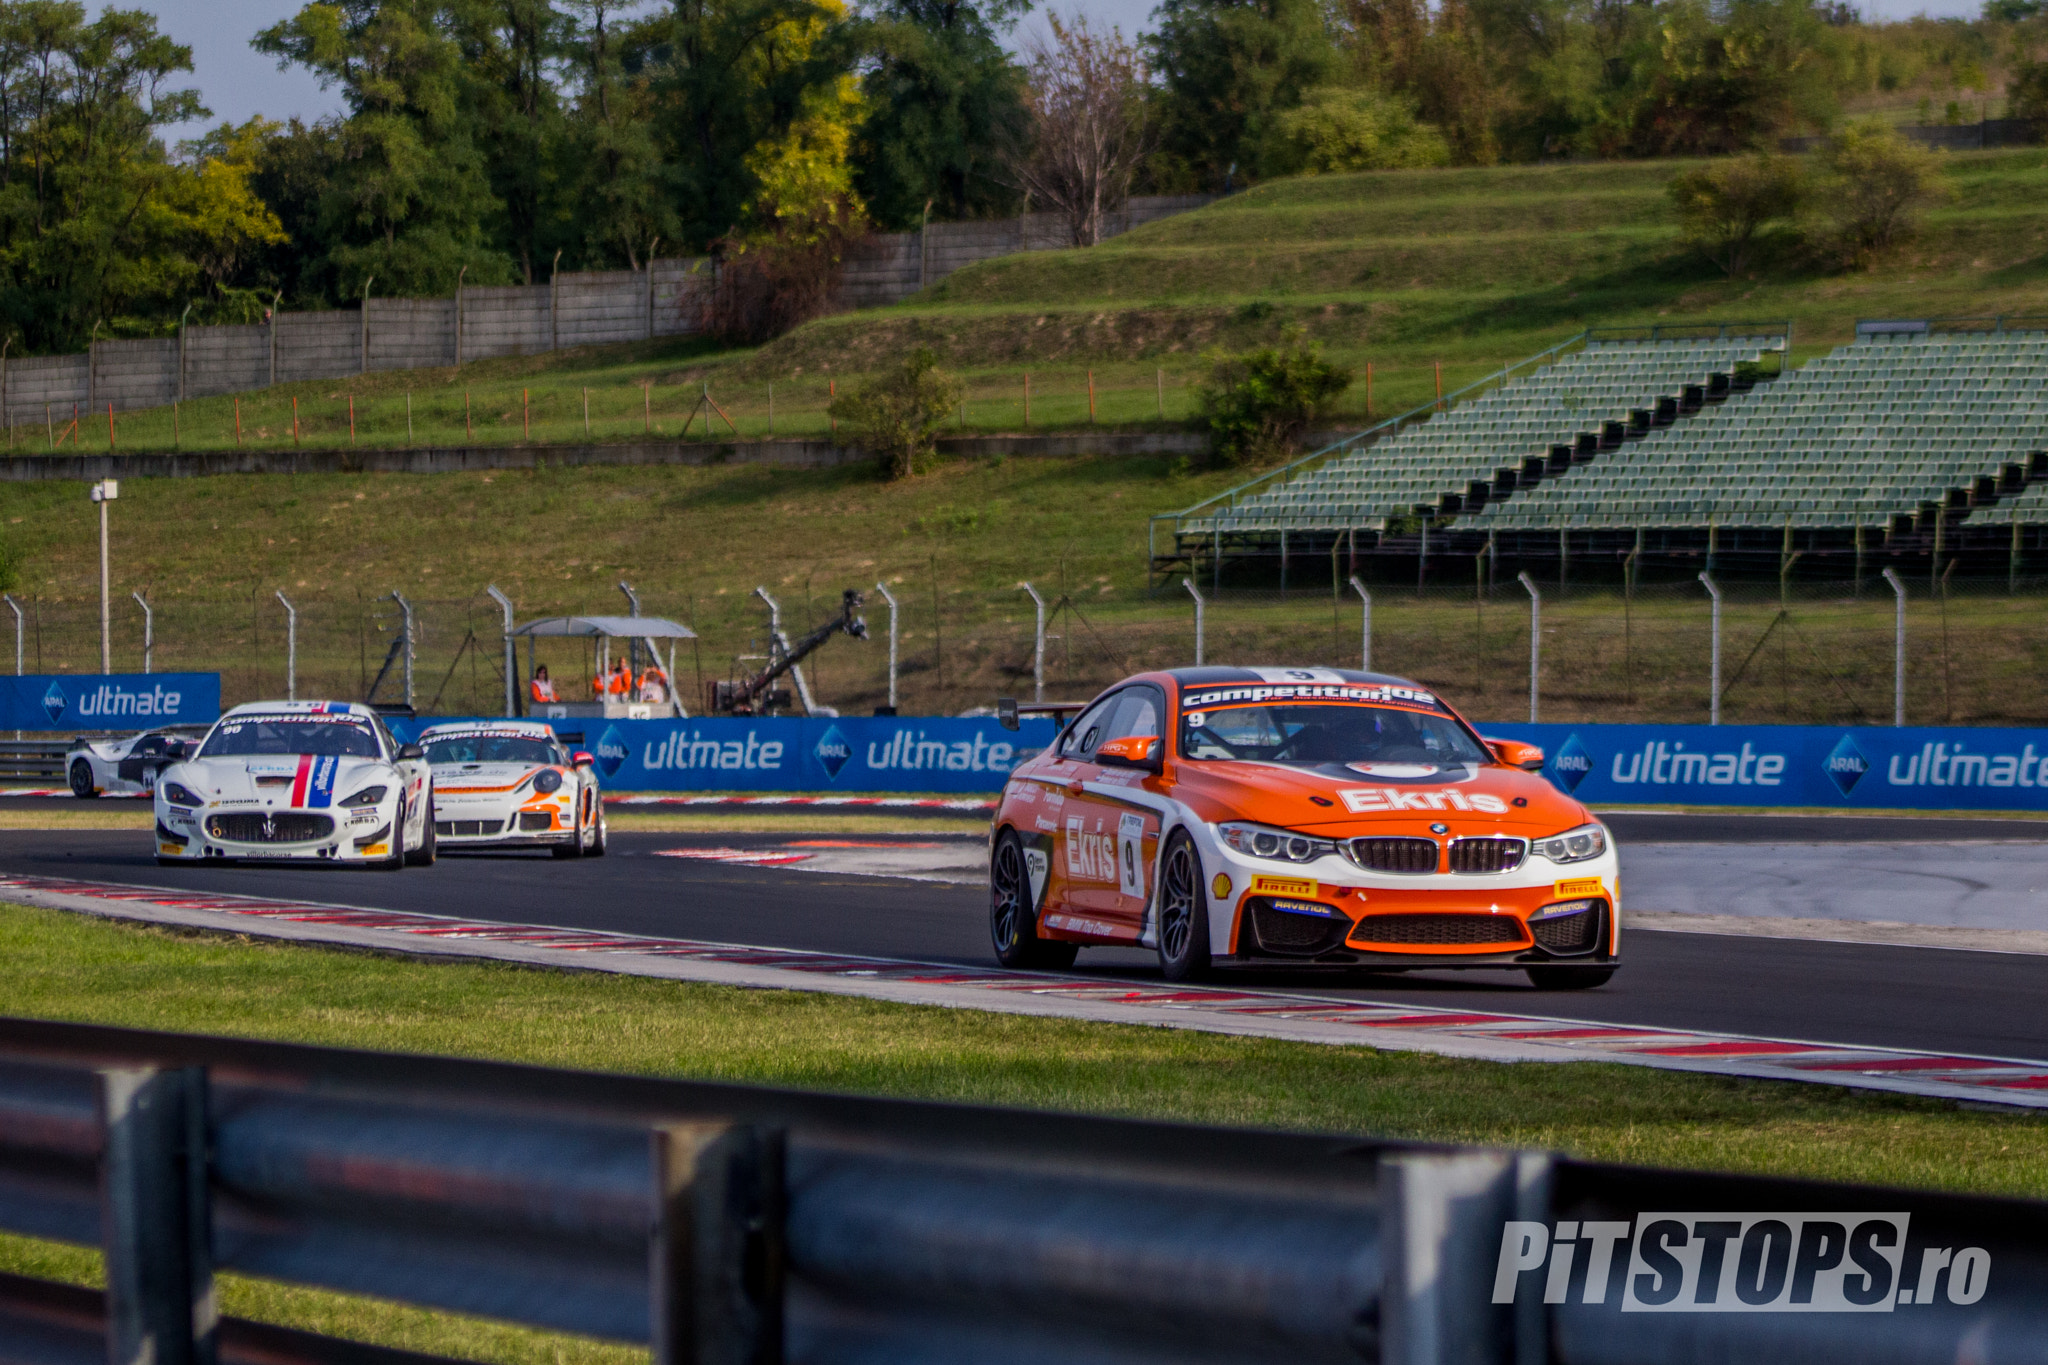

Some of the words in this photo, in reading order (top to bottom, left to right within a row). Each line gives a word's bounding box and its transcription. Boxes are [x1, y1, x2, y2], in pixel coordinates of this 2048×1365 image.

[79, 684, 181, 716] ultimate
[222, 724, 243, 735] 90
[1187, 711, 1206, 728] 9
[597, 741, 625, 759] ARAL
[643, 730, 784, 770] ultimate
[819, 743, 847, 758] ARAL
[867, 730, 1013, 772] ultimate
[1555, 755, 1588, 771] ARAL
[1611, 741, 1786, 786] ultimate
[1829, 757, 1863, 773] ARAL
[1336, 788, 1509, 814] Ekris
[1066, 814, 1116, 884] Ekris
[1124, 839, 1135, 887] 9
[1256, 878, 1311, 894] PIRELLI
[1560, 880, 1599, 894] PIRELLI
[1274, 901, 1331, 914] RAVENOL
[1543, 901, 1587, 915] RAVENOL
